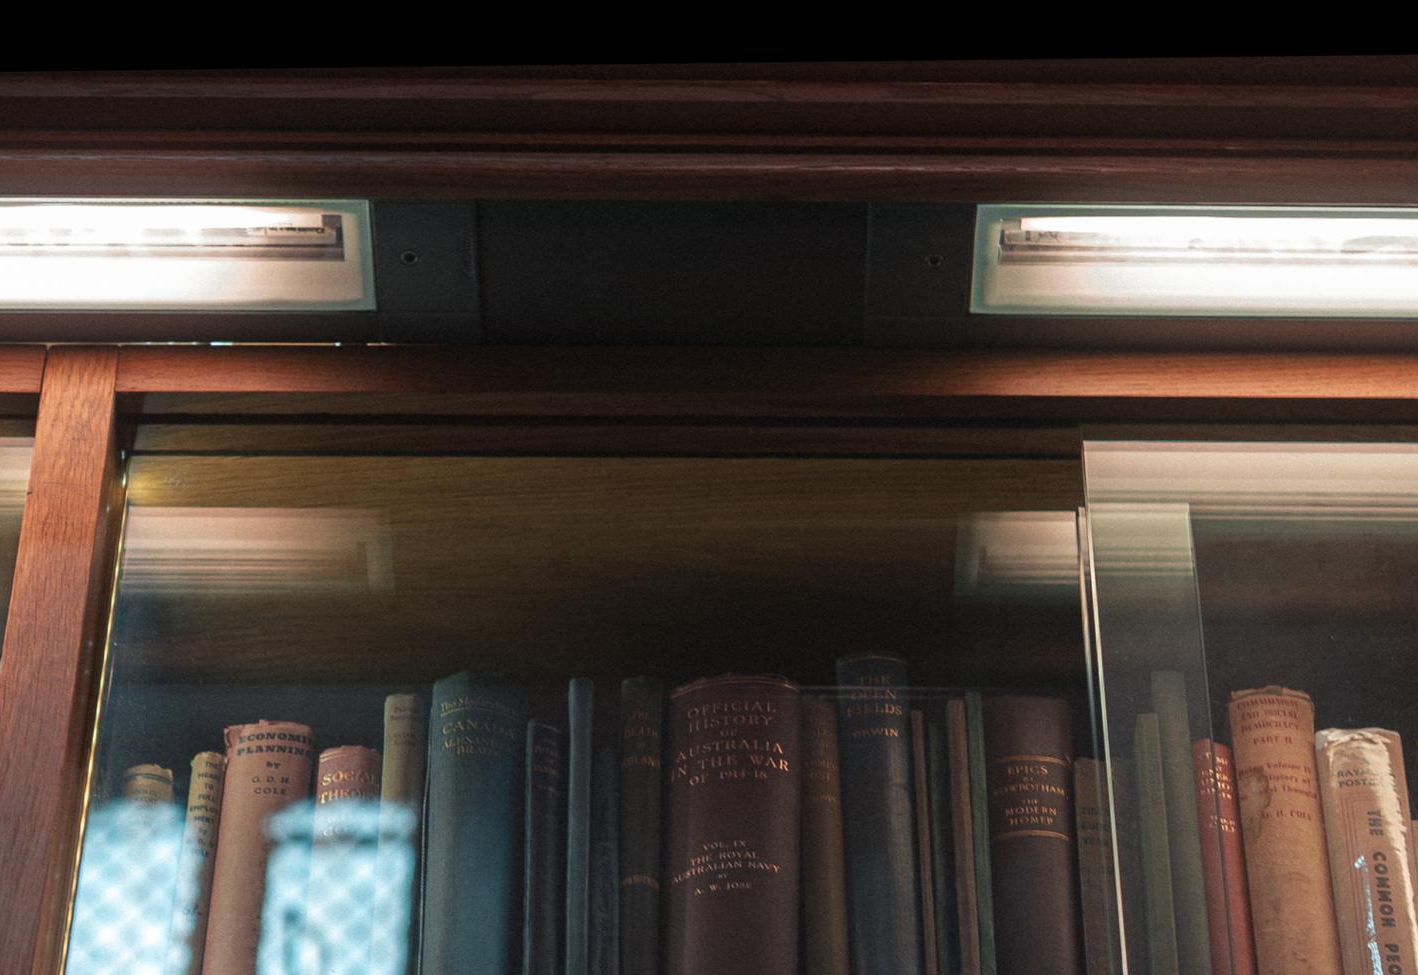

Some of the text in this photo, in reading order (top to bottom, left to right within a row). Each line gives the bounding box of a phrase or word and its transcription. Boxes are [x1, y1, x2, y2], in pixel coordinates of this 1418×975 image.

[687, 701, 777, 720] OFFICIAL
[847, 703, 903, 717] FIELDS
[1241, 710, 1260, 721] AND
[441, 719, 515, 738] CANADA
[688, 714, 774, 733] HISTORY
[1241, 722, 1299, 734] DEMOCRACY
[720, 728, 738, 737] OF
[853, 727, 899, 737] ORWIN
[1253, 736, 1279, 746] PART
[236, 745, 311, 757] PLANNIN
[676, 738, 784, 763] AUSTRALIA
[699, 754, 790, 772] THE WAR
[1007, 765, 1049, 775] EPICS
[322, 771, 378, 786] SOCIAL
[688, 773, 708, 786] OF
[254, 787, 287, 796] COLE
[1005, 807, 1057, 816] MODERN
[1290, 810, 1312, 820] COLE
[1009, 817, 1054, 826] HOMER
[1367, 809, 1384, 837] THE
[690, 851, 760, 867] THE ROYAL
[672, 861, 743, 884] AUSTRALIAN
[748, 862, 781, 874] NAVY
[1372, 850, 1397, 929] COMMON
